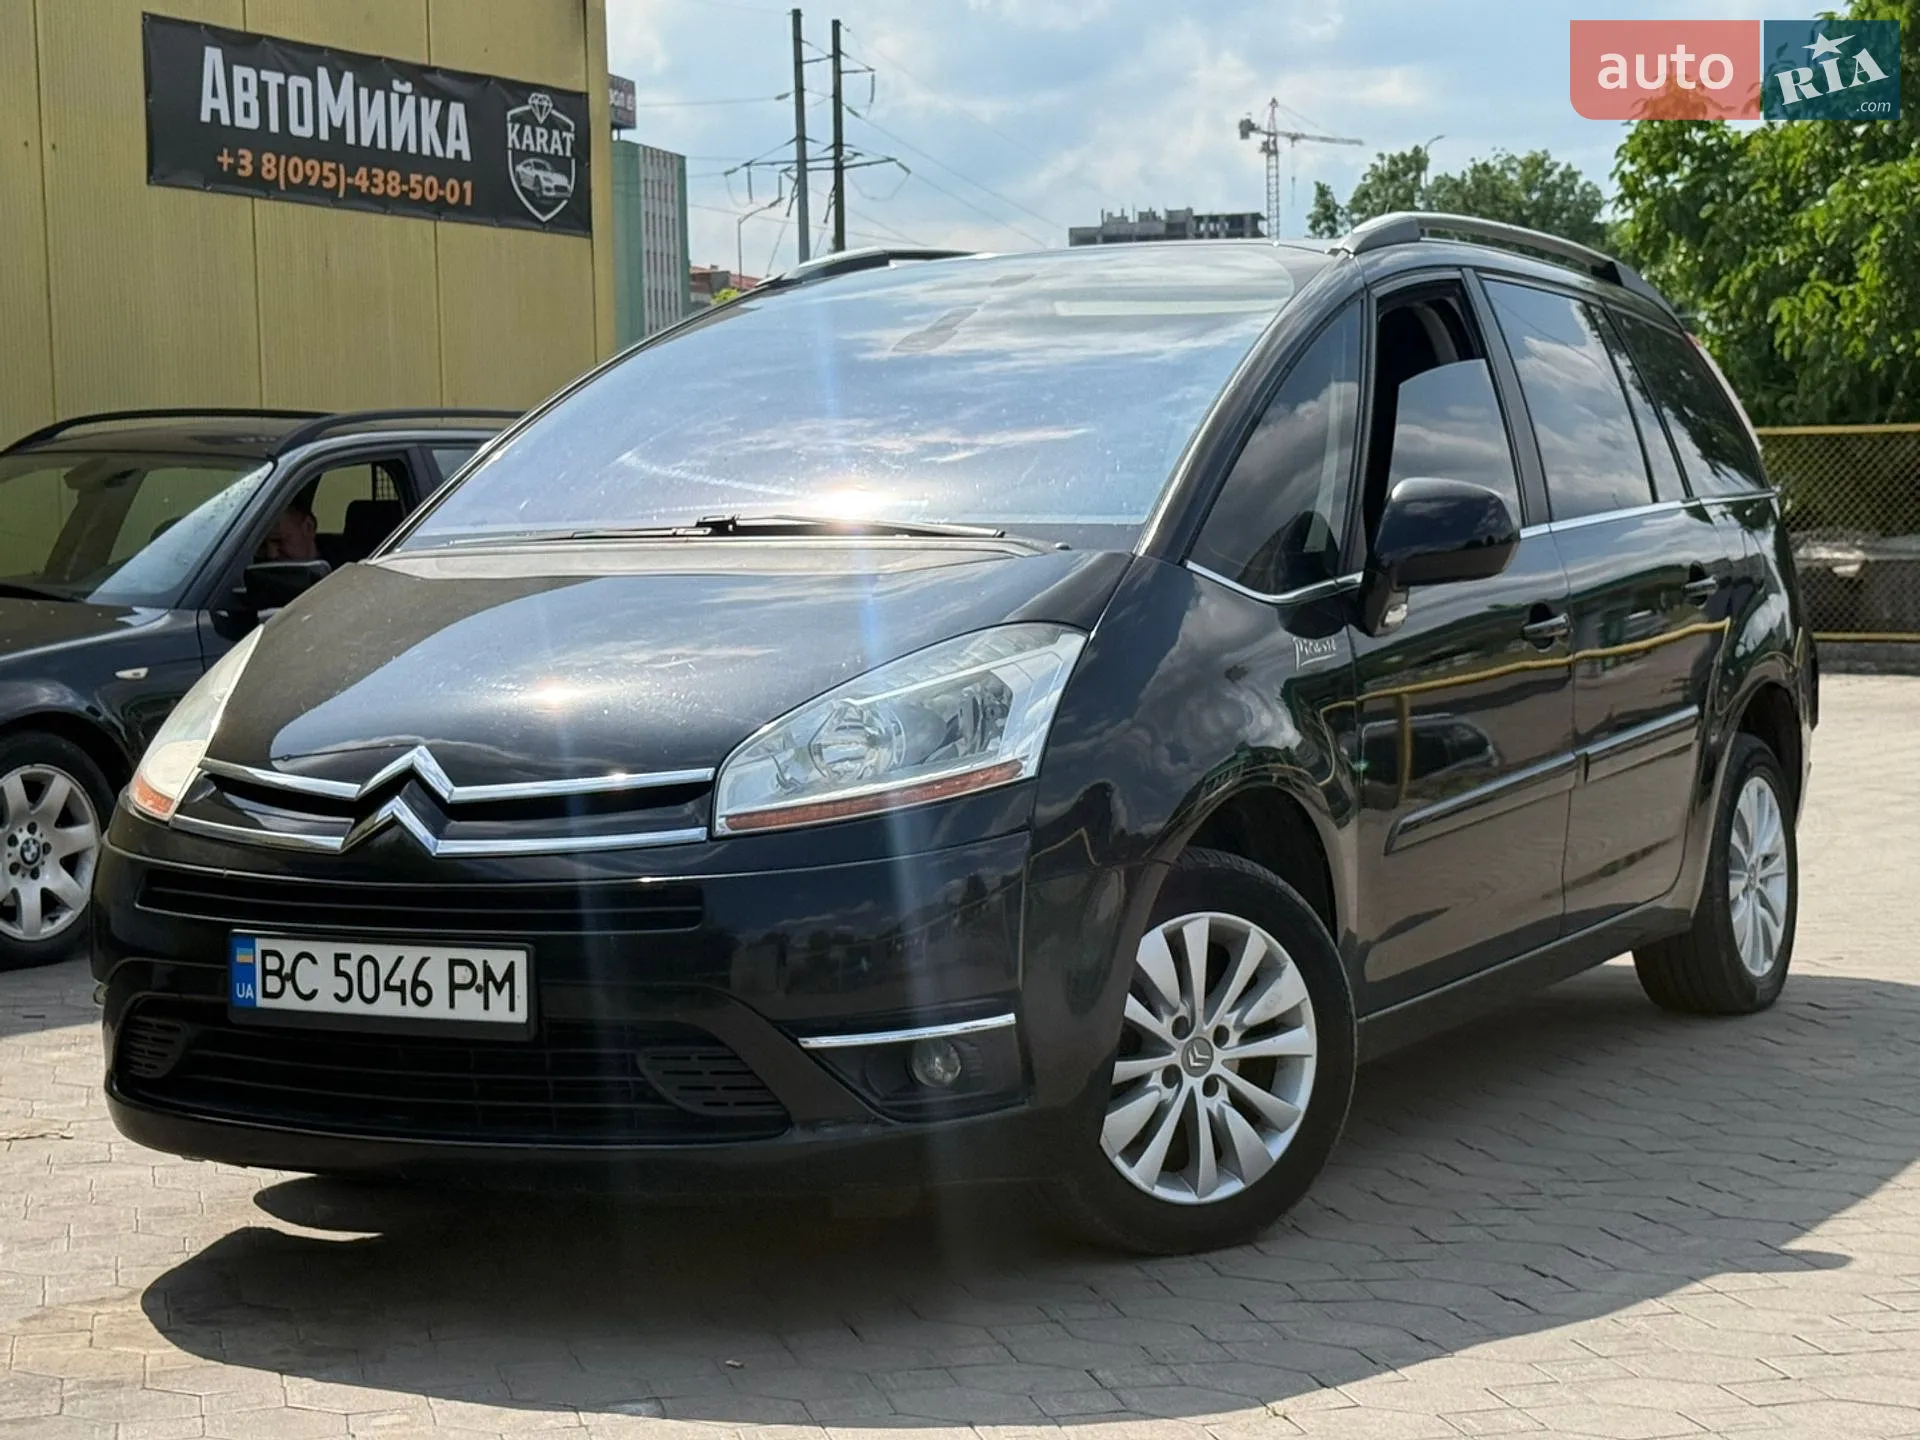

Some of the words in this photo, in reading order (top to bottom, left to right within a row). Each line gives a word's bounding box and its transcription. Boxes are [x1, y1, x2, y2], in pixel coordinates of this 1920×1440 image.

[507, 122, 575, 157] KARAT
[235, 982, 254, 1000] UA
[332, 952, 434, 1008] 5046
